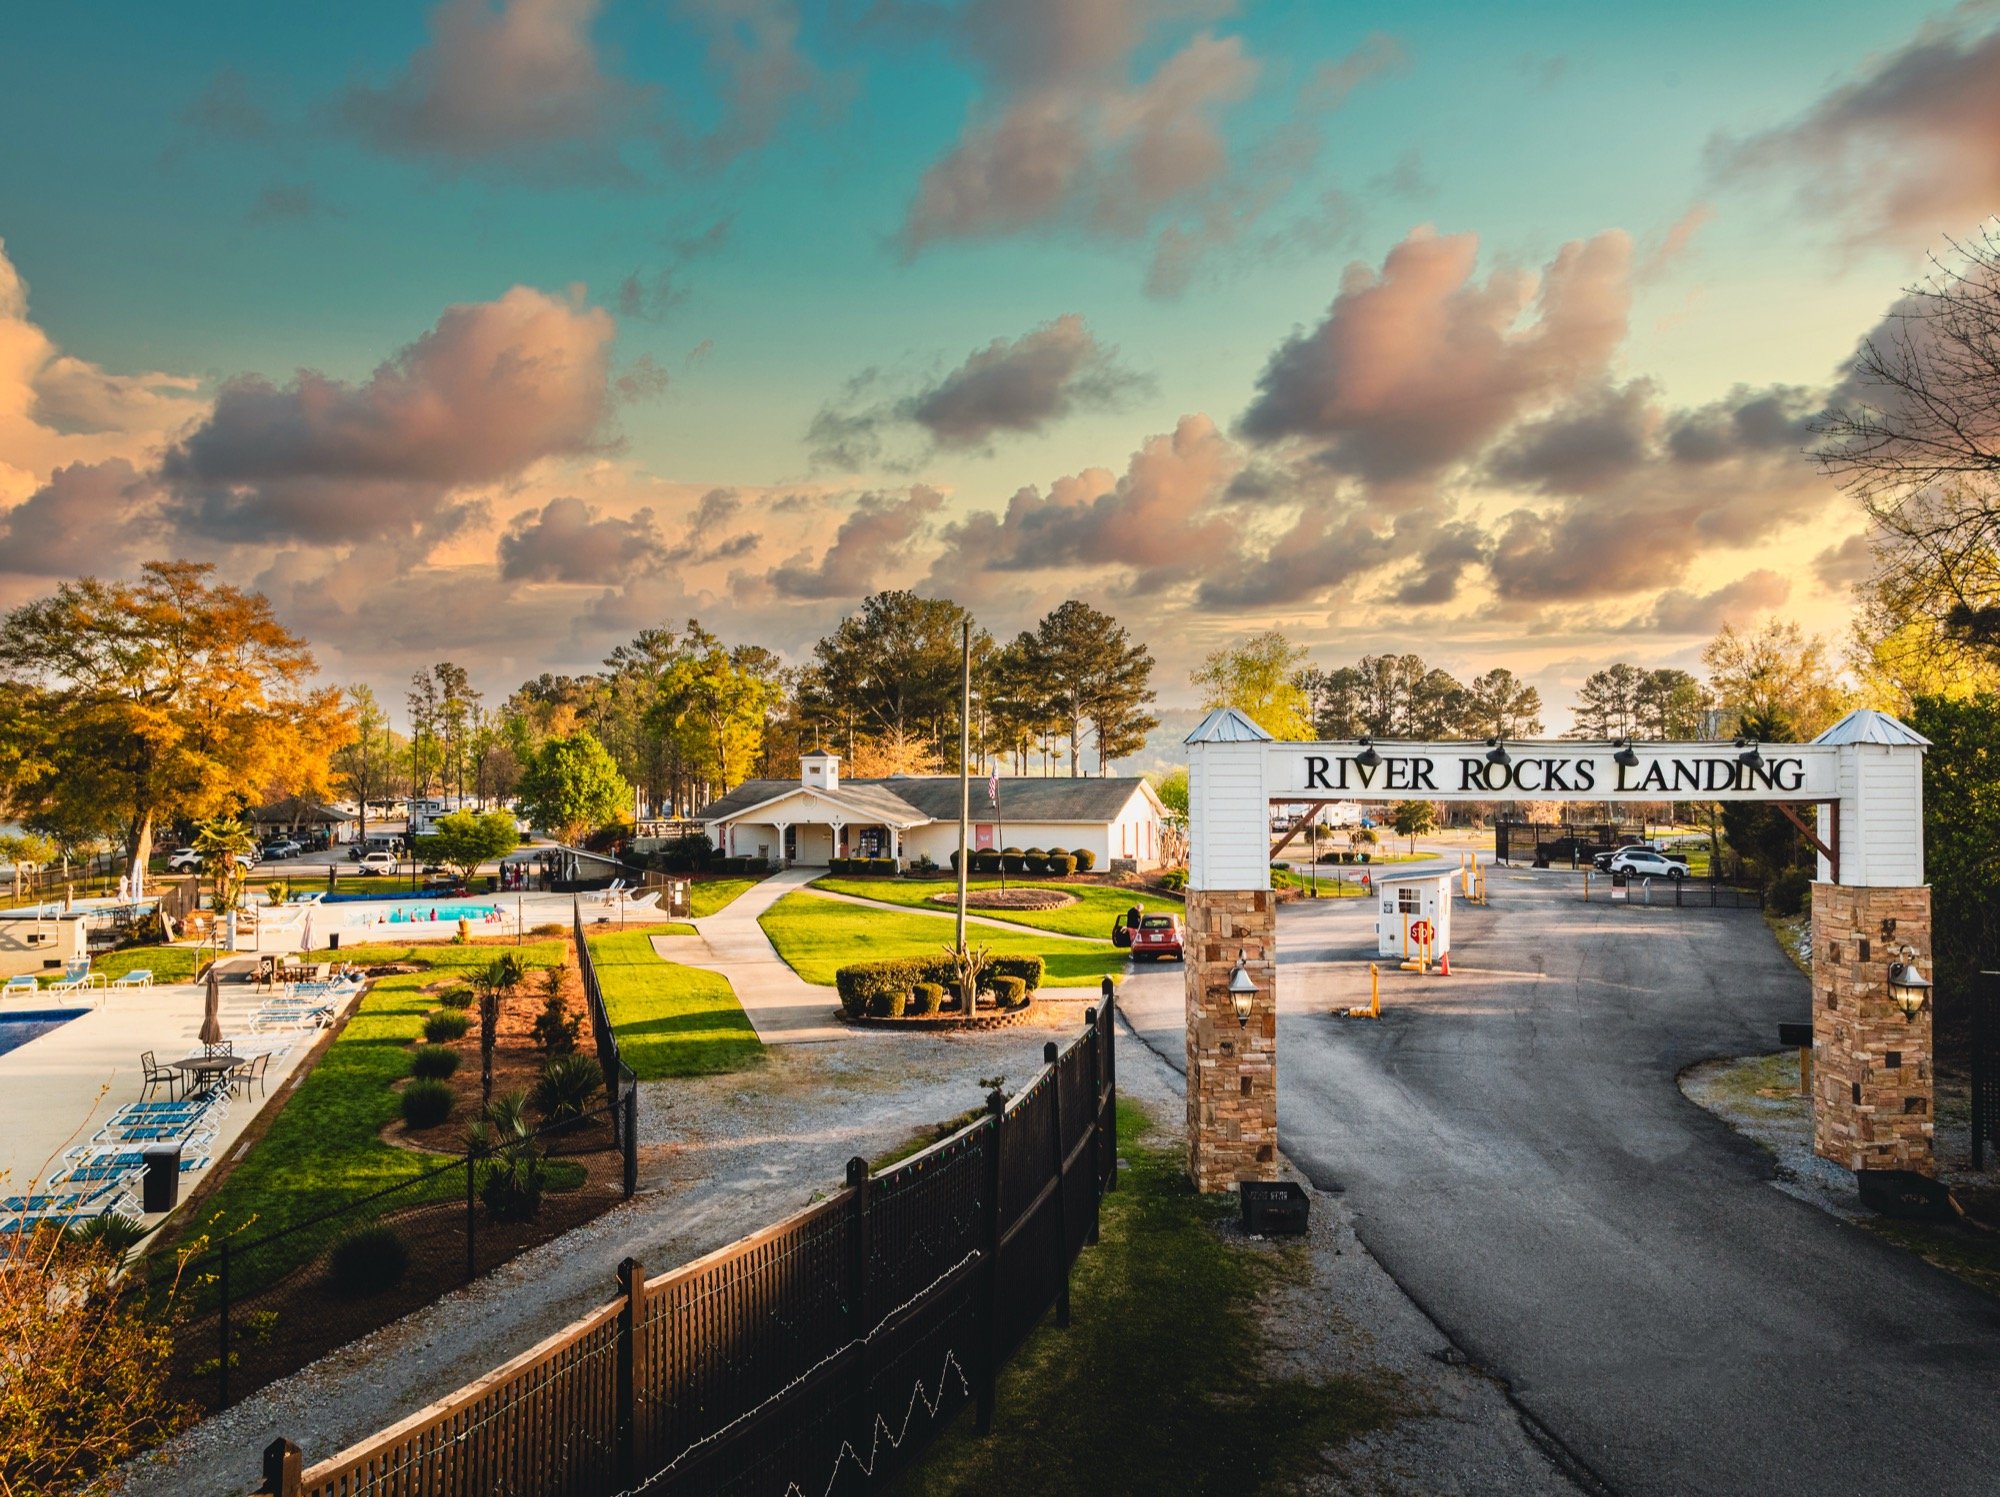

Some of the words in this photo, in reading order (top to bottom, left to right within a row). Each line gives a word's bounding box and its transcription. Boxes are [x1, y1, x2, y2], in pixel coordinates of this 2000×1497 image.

[1304, 756, 1439, 790] RIVER
[1458, 758, 1595, 791] ROCKS
[1613, 758, 1805, 791] LANDING
[1411, 927, 1434, 938] SO
